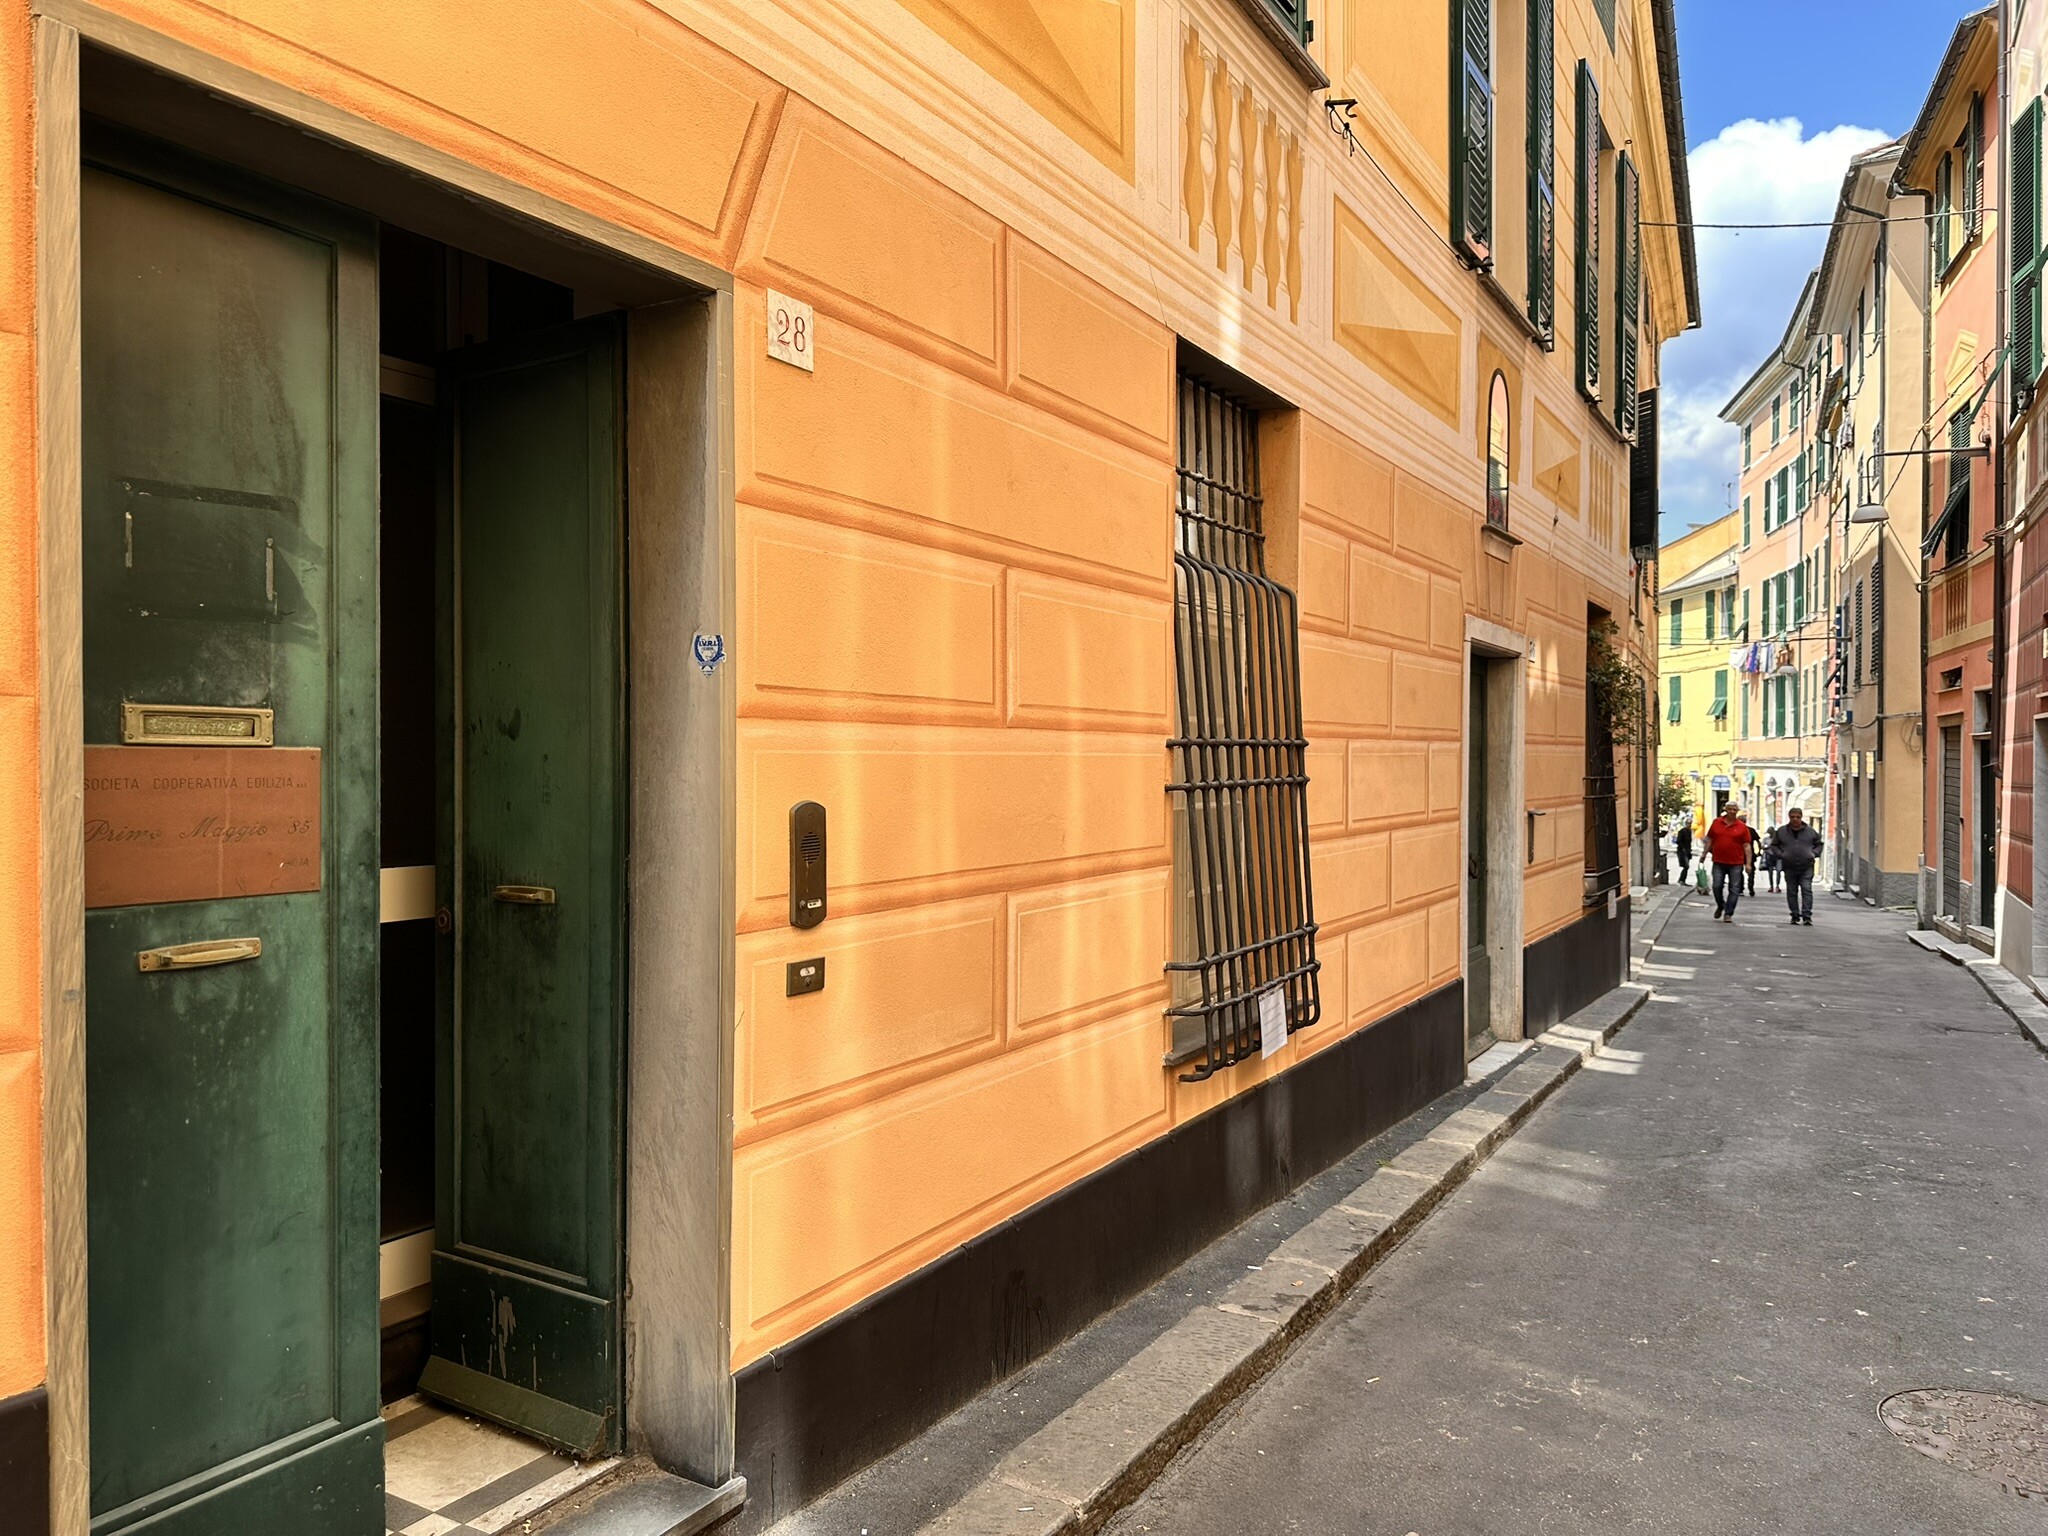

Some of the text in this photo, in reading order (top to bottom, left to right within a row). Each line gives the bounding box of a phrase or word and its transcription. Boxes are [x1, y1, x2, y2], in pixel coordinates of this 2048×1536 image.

[776, 308, 806, 353] 28
[153, 777, 238, 790] COOPERATIVA
[247, 777, 293, 789] EDILIZIA
[84, 819, 162, 842] Primo
[179, 816, 267, 843] Maggio
